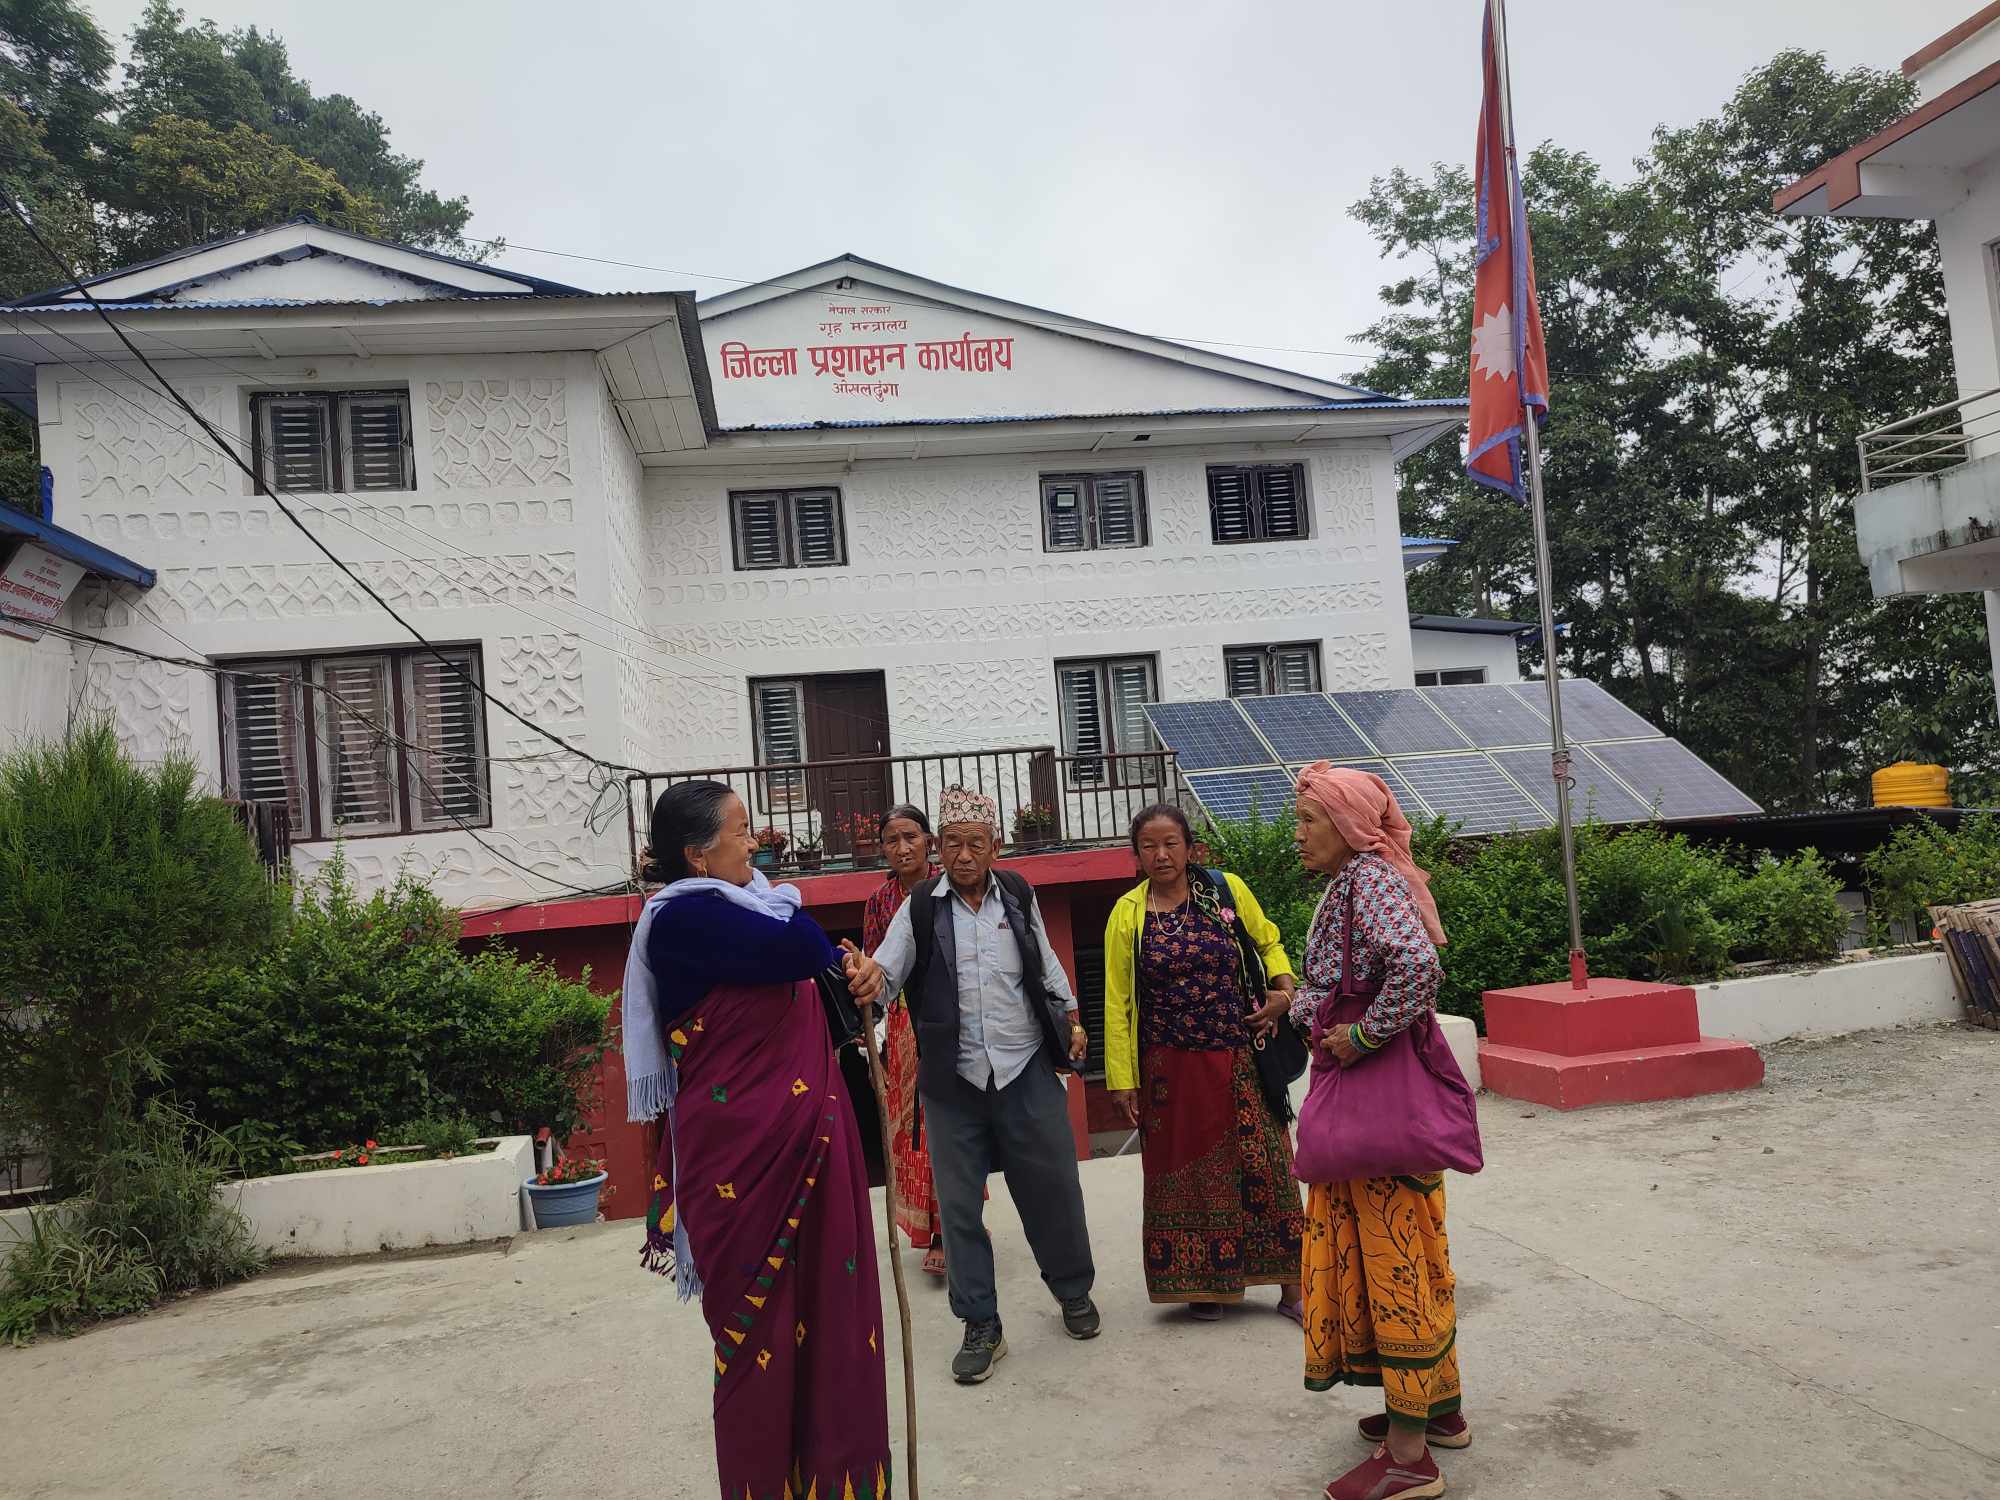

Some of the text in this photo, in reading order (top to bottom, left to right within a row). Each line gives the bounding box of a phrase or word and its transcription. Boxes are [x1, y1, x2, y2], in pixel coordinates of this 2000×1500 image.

[829, 302, 891, 315] नेपाल सरकार
[817, 320, 907, 338] गृह मन्त्रालय
[720, 332, 1015, 379] जिल्ला प्रशासन कार्यालय
